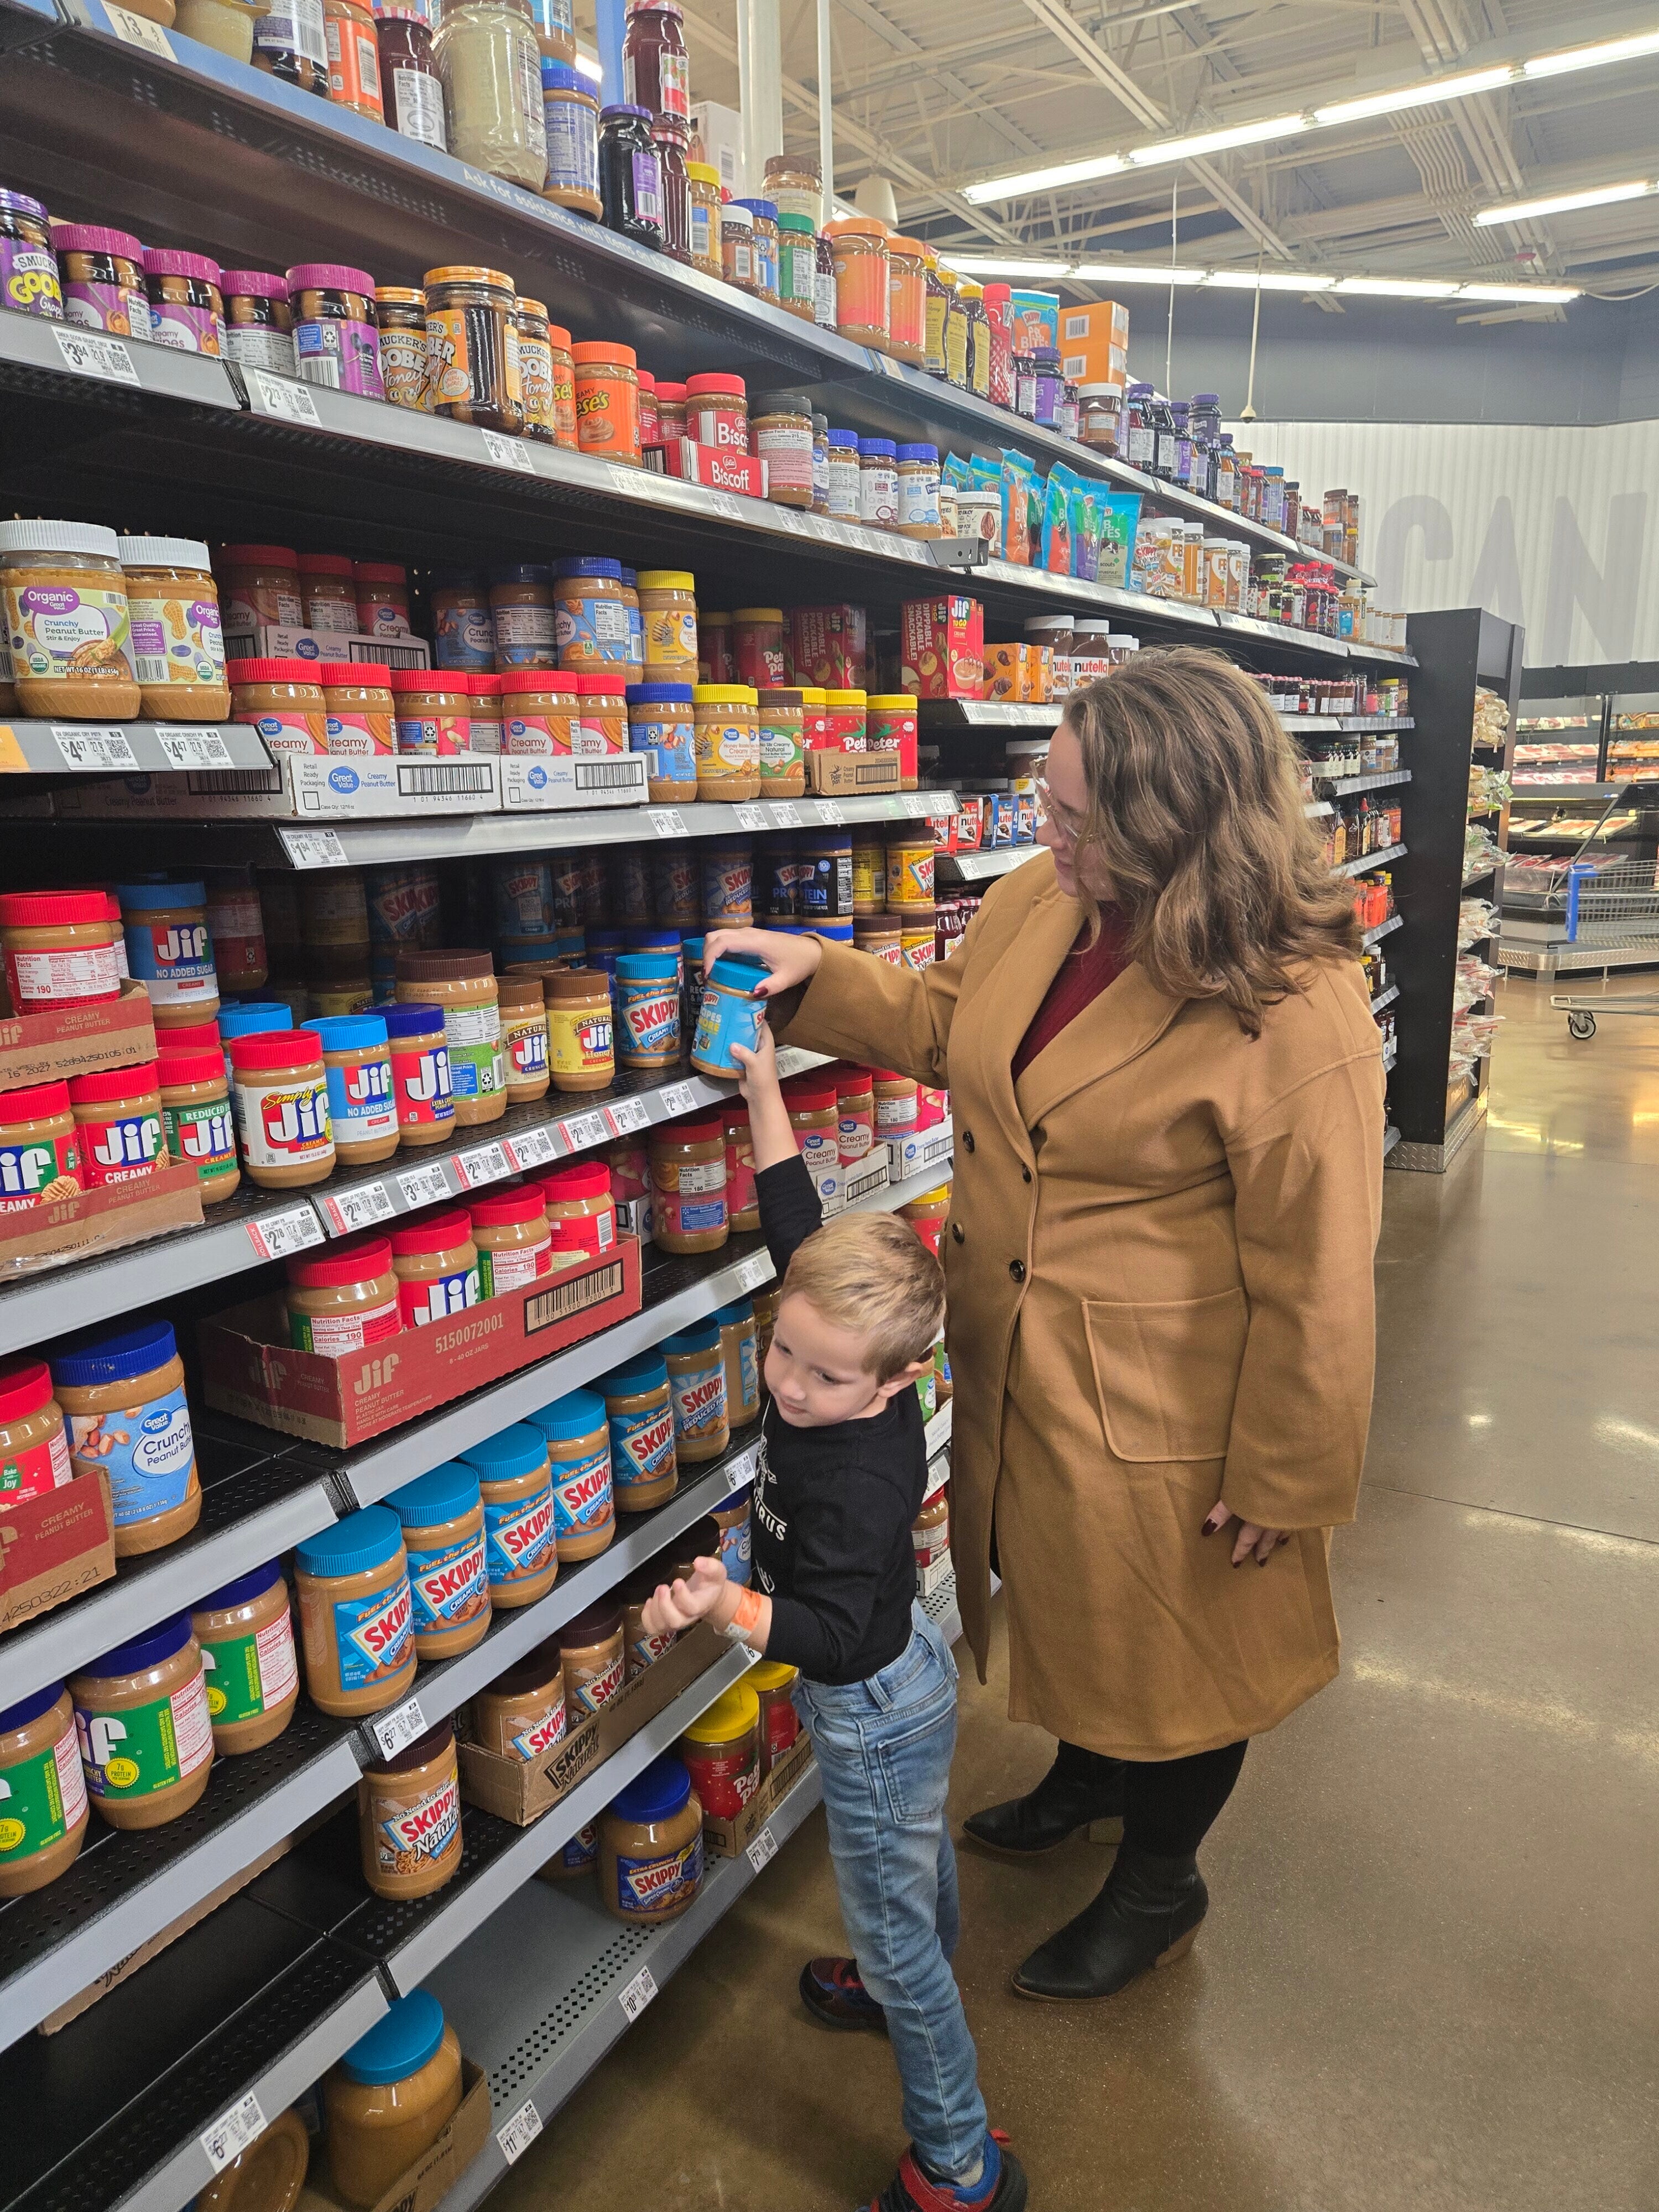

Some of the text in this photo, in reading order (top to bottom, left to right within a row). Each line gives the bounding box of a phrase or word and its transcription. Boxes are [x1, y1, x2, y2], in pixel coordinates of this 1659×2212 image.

[116, 11, 142, 36] 13
[463, 168, 488, 189] Ask
[491, 177, 512, 200] for
[515, 193, 576, 227] assistance
[576, 219, 603, 241] with
[602, 233, 633, 256] items
[635, 247, 648, 261] on
[712, 461, 749, 490] Biscoff
[28, 591, 74, 603] Organic
[952, 601, 969, 618] Jif
[44, 620, 79, 628] Crunchy
[45, 627, 77, 635] Peanut
[298, 643, 314, 651] Great
[511, 738, 546, 750] Creamy
[331, 773, 353, 783] Great
[367, 773, 387, 781] Creamy
[952, 816, 957, 828] 4
[157, 926, 208, 961] Jif
[156, 966, 213, 978] NO ADDED SUGAR
[36, 985, 51, 994] 190
[65, 1012, 100, 1025] CREAMY
[629, 998, 680, 1034] SKIPPY
[56, 1018, 111, 1034] PEANUT BUTTER
[648, 1026, 669, 1043] CREAMY
[515, 1037, 547, 1066] Jif
[585, 1049, 611, 1060] Honey
[27, 1065, 50, 1075] 2027
[348, 1063, 391, 1099] Jif
[263, 1087, 314, 1110] Simply
[185, 1107, 224, 1121] REDUCED
[268, 1092, 329, 1142] Jif
[94, 1118, 160, 1165] Jif
[301, 1139, 323, 1147] CREAMY
[839, 1133, 869, 1142] Creamy
[204, 1153, 232, 1164] CREAMY
[105, 1165, 153, 1184] CREAMY
[48, 1202, 80, 1224] Jif
[329, 1202, 343, 1230] ROLLBACK
[311, 1314, 361, 1326] Nutrition Facts
[314, 1331, 362, 1343] Calories 190
[435, 1313, 504, 1355] 5150072001
[354, 1354, 400, 1395] Jif
[354, 1392, 381, 1407] CREAMY
[355, 1389, 405, 1415] PEANUT BUTTER
[681, 1375, 723, 1414] SKIPPY
[144, 1413, 168, 1428] Great
[356, 1405, 384, 1420] PLASTIC JAR
[356, 1404, 399, 1427] HANDLE WITH CARE
[357, 1422, 372, 1431] STORE
[377, 1408, 402, 1423] MODERATE
[401, 1395, 432, 1413] TEMPERATURE
[151, 1420, 168, 1431] Value
[143, 1421, 191, 1455] Crunchy
[147, 1446, 179, 1467] Peanut
[3, 1468, 17, 1476] Bake
[3, 1478, 18, 1490] Joy
[35, 1508, 93, 1541] PEANUT BUTTER
[40, 1502, 85, 1529] CREAMY
[424, 1548, 485, 1604] SKIPPY
[449, 1585, 474, 1611] CREAMY
[553, 1721, 601, 1776] SKIPPY
[116, 1763, 124, 1771] 7g
[392, 1813, 405, 1822] No
[405, 1801, 426, 1818] Need
[426, 1794, 436, 1804] to
[400, 1786, 455, 1842] SKIPPY
[635, 1862, 682, 1894] SKIPPY
